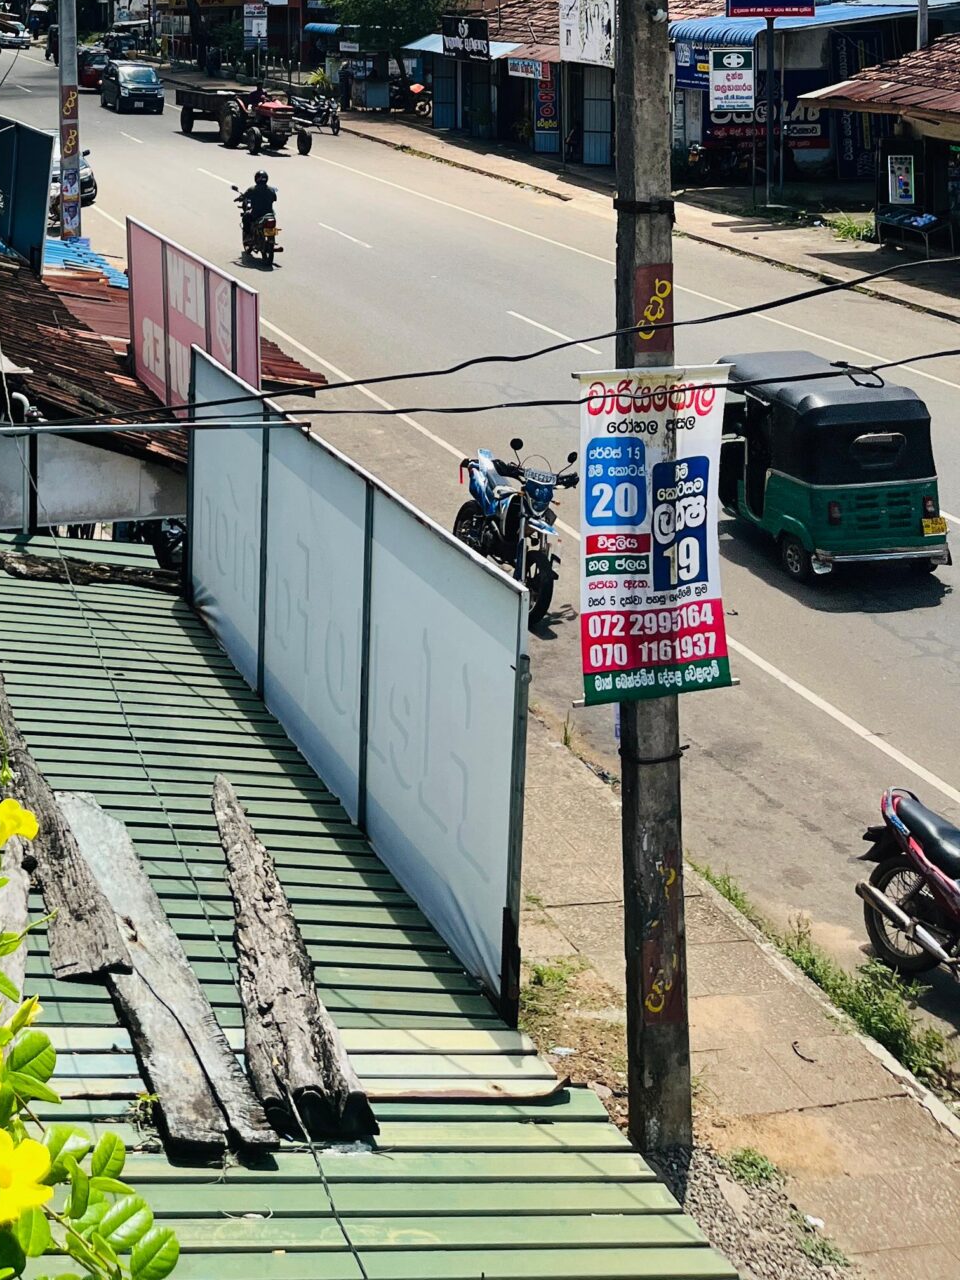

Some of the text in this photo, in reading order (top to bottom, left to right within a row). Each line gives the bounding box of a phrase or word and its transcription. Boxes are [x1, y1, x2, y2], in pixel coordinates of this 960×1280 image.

[607, 416, 696, 434] රෝහල අසල
[627, 447, 640, 459] 15
[592, 482, 638, 518] 20
[597, 535, 638, 551] විදුලිය
[588, 558, 647, 572] නල ජලය
[663, 537, 700, 585] 19
[588, 580, 618, 591] සපයා
[588, 595, 606, 608] වසර
[610, 596, 616, 606] 5
[646, 593, 666, 606] පහසු
[588, 603, 714, 638] 072 2995164
[589, 632, 716, 668] 070 1161937
